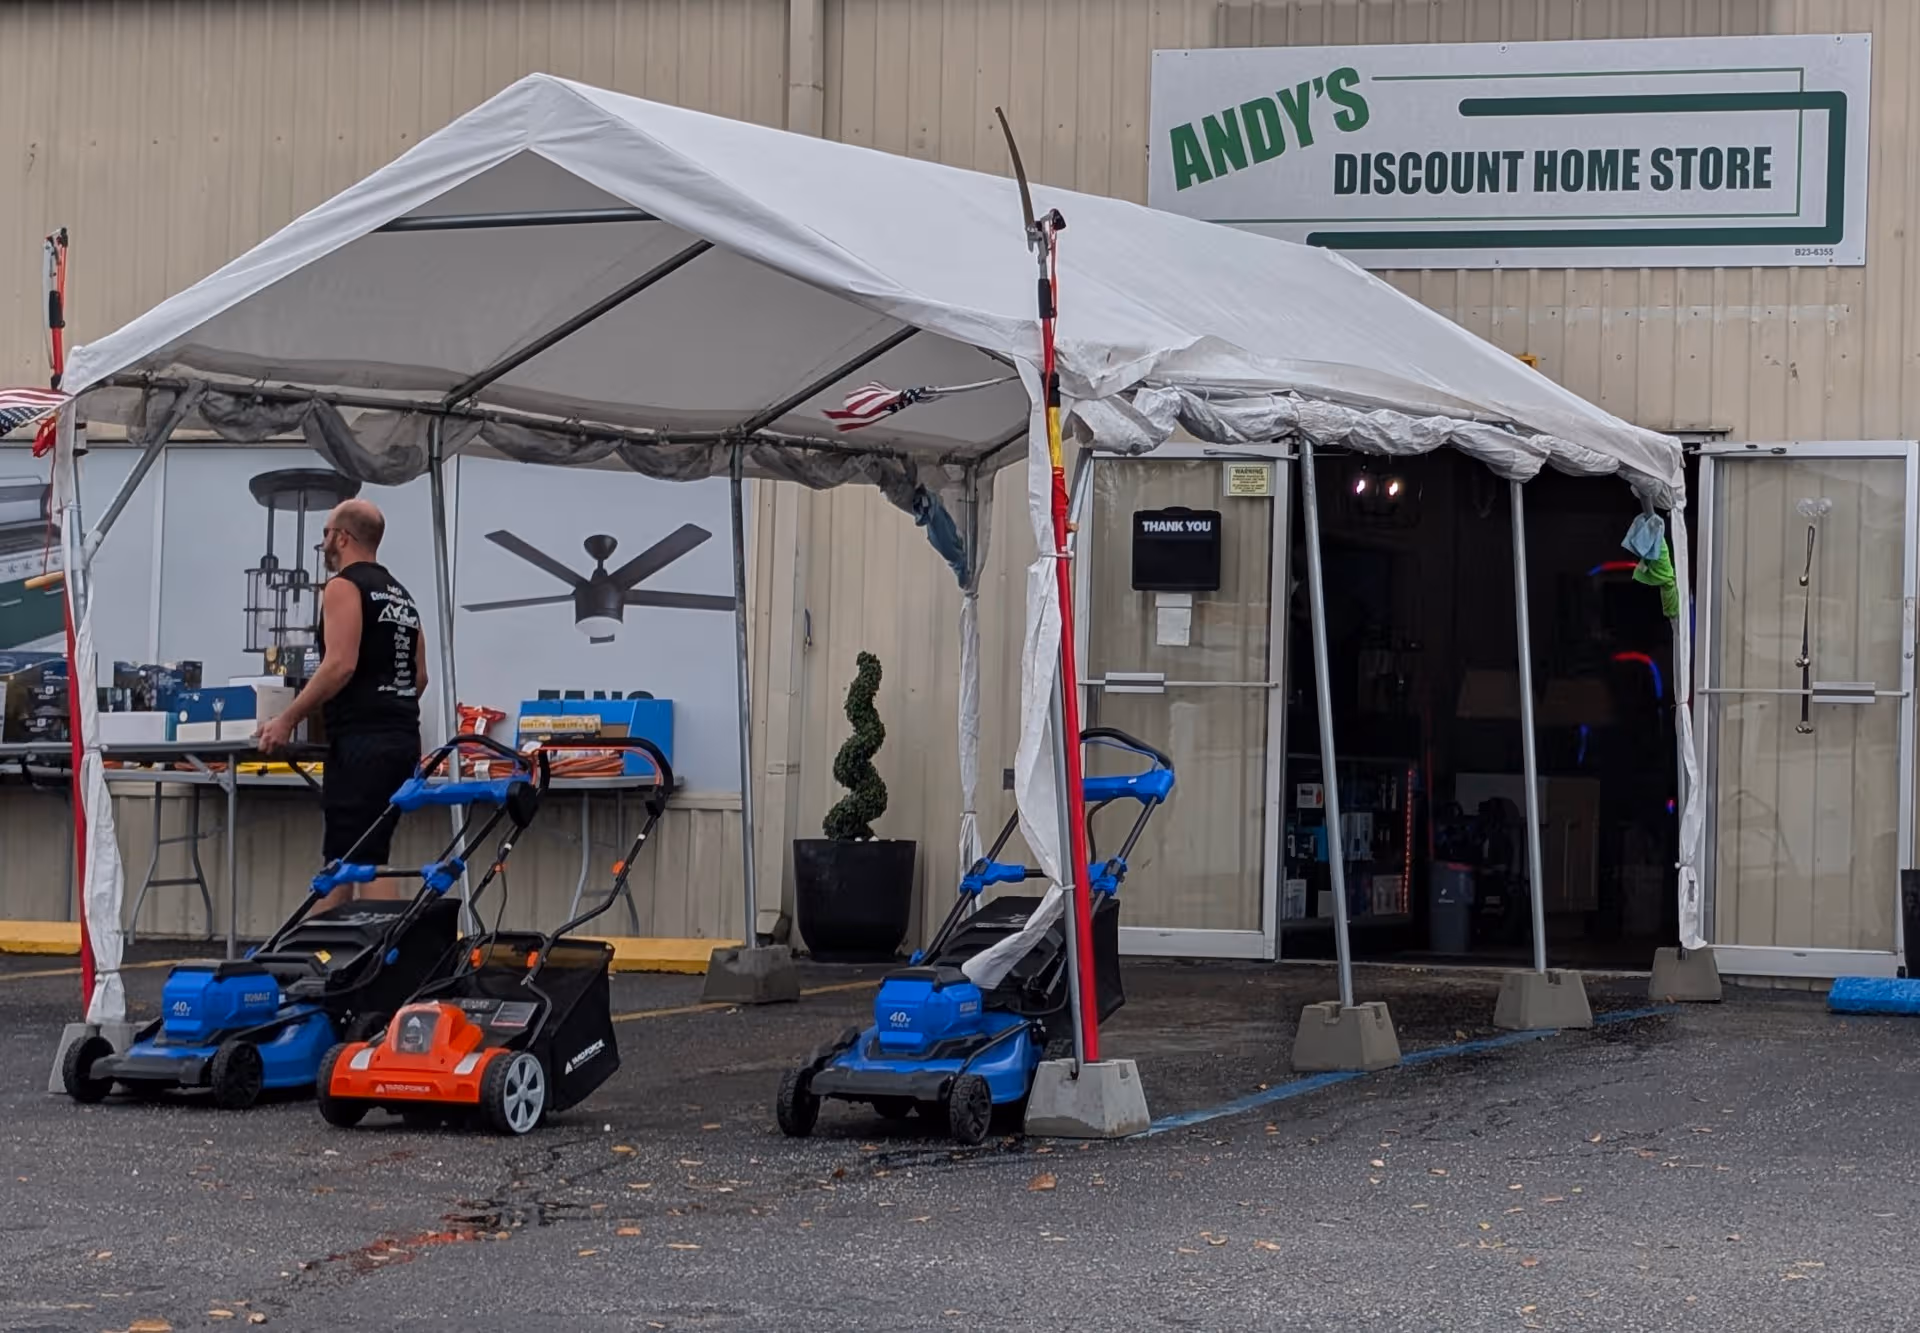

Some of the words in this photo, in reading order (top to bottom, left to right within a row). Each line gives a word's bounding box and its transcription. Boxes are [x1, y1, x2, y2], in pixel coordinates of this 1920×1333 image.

[1170, 67, 1370, 191] ANDY'S
[1334, 150, 1525, 195] DISCOUNT
[1533, 148, 1641, 193] HOME
[1651, 146, 1772, 191] STORE
[1794, 248, 1834, 256] B23-6355
[1142, 520, 1184, 532] THANK
[1185, 520, 1212, 532] YOU
